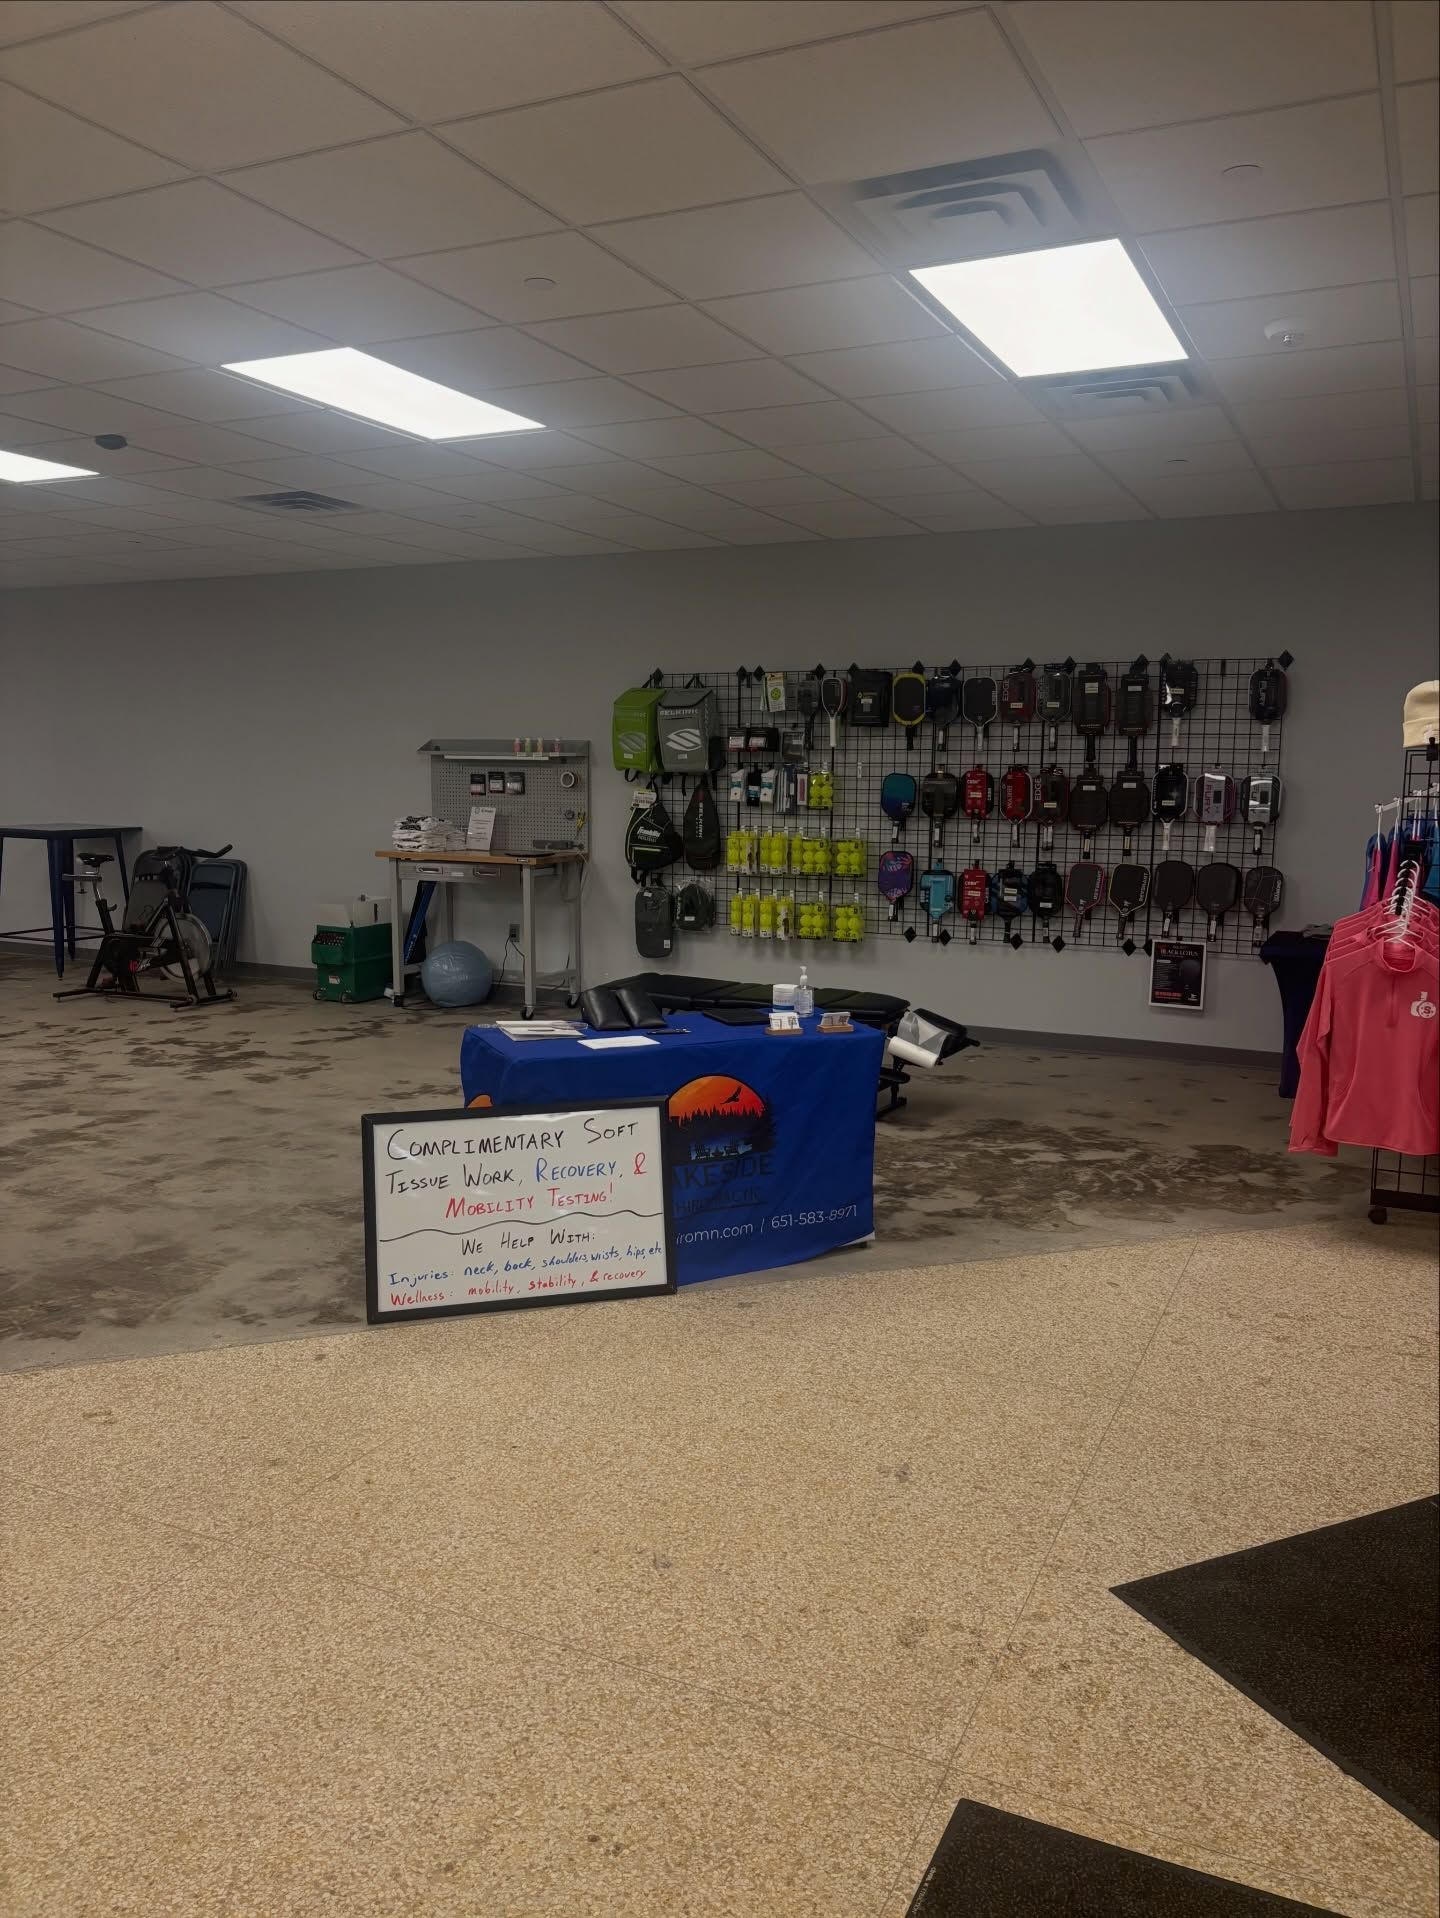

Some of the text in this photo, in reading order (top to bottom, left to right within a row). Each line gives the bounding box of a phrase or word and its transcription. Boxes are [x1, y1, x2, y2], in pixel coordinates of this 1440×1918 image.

[1034, 777, 1042, 801] EDGE
[633, 1151, 648, 1175] &
[771, 1204, 858, 1229] 651-583-8971
[463, 1261, 499, 1277] neck,
[590, 1245, 623, 1262] wrists,
[588, 1269, 600, 1283] &
[602, 1268, 648, 1282] recovery
